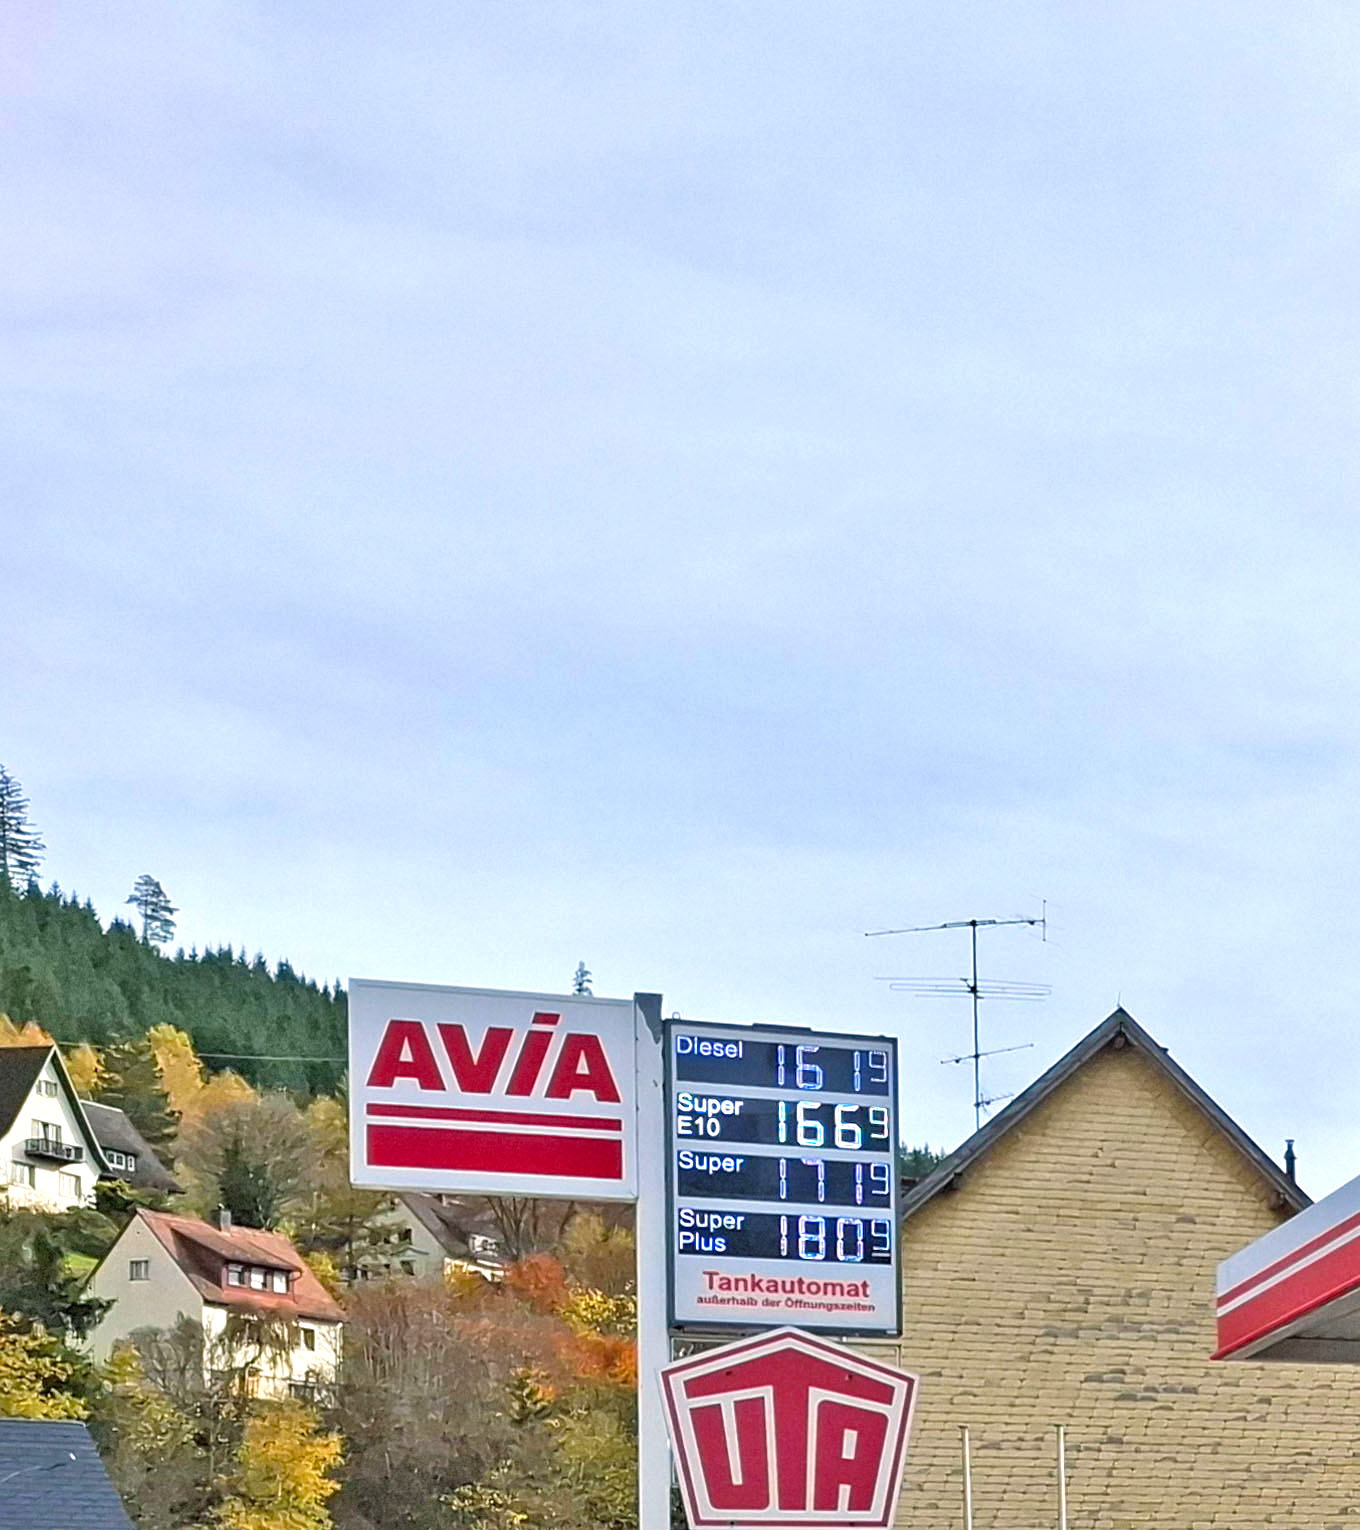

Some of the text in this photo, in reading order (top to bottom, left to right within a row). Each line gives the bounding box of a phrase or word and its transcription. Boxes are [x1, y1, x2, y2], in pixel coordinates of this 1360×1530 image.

[367, 1012, 621, 1103] AVIA
[676, 1035, 743, 1058] Diesel
[677, 1092, 743, 1115] Super
[677, 1117, 721, 1136] E10
[678, 1151, 744, 1174] Super
[679, 1208, 745, 1231] Super
[679, 1231, 727, 1251] Plus
[703, 1270, 870, 1298] Tankautomat
[696, 1295, 876, 1312] außerhalb der Öffnungszeiten
[684, 1349, 895, 1512] UTA
